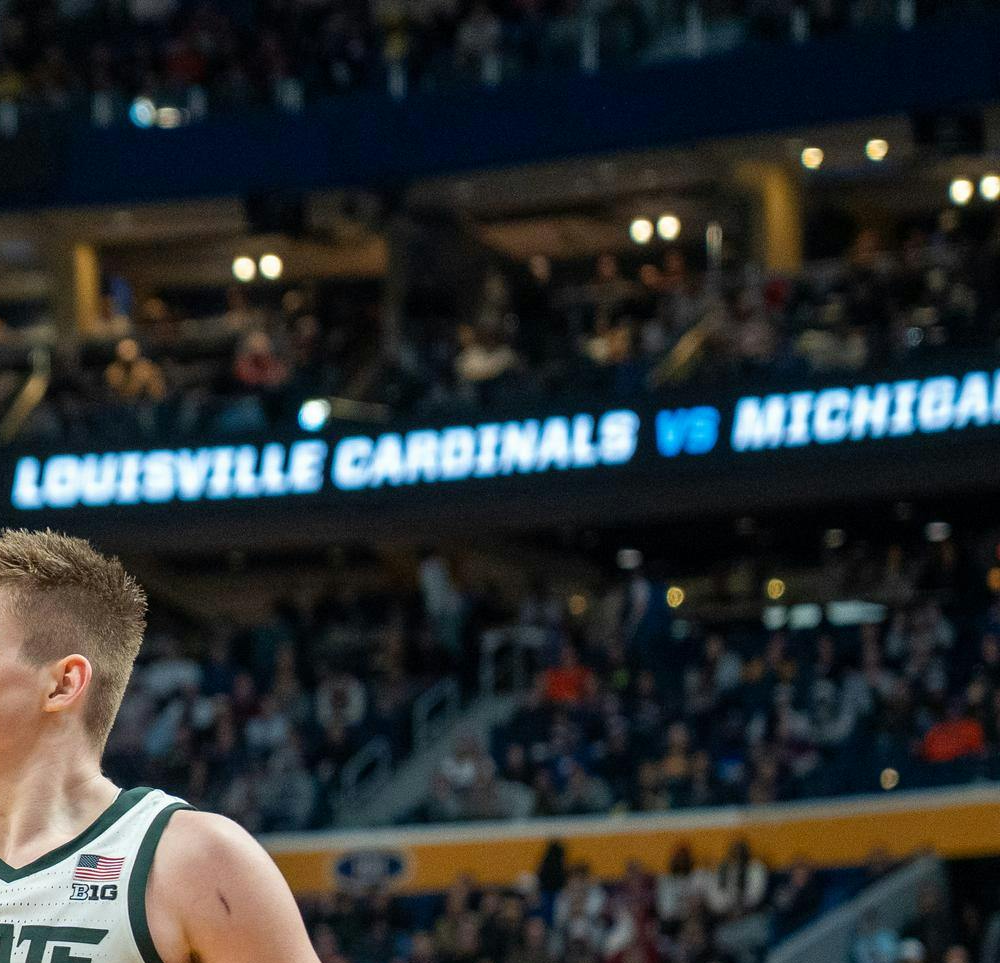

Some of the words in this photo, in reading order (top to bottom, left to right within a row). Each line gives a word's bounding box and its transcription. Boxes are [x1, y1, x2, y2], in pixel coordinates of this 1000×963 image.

[11, 440, 328, 510] LOUISVILLE
[331, 408, 641, 491] CARDINALS
[655, 405, 721, 457] VS
[731, 369, 1000, 452] MICHIGA
